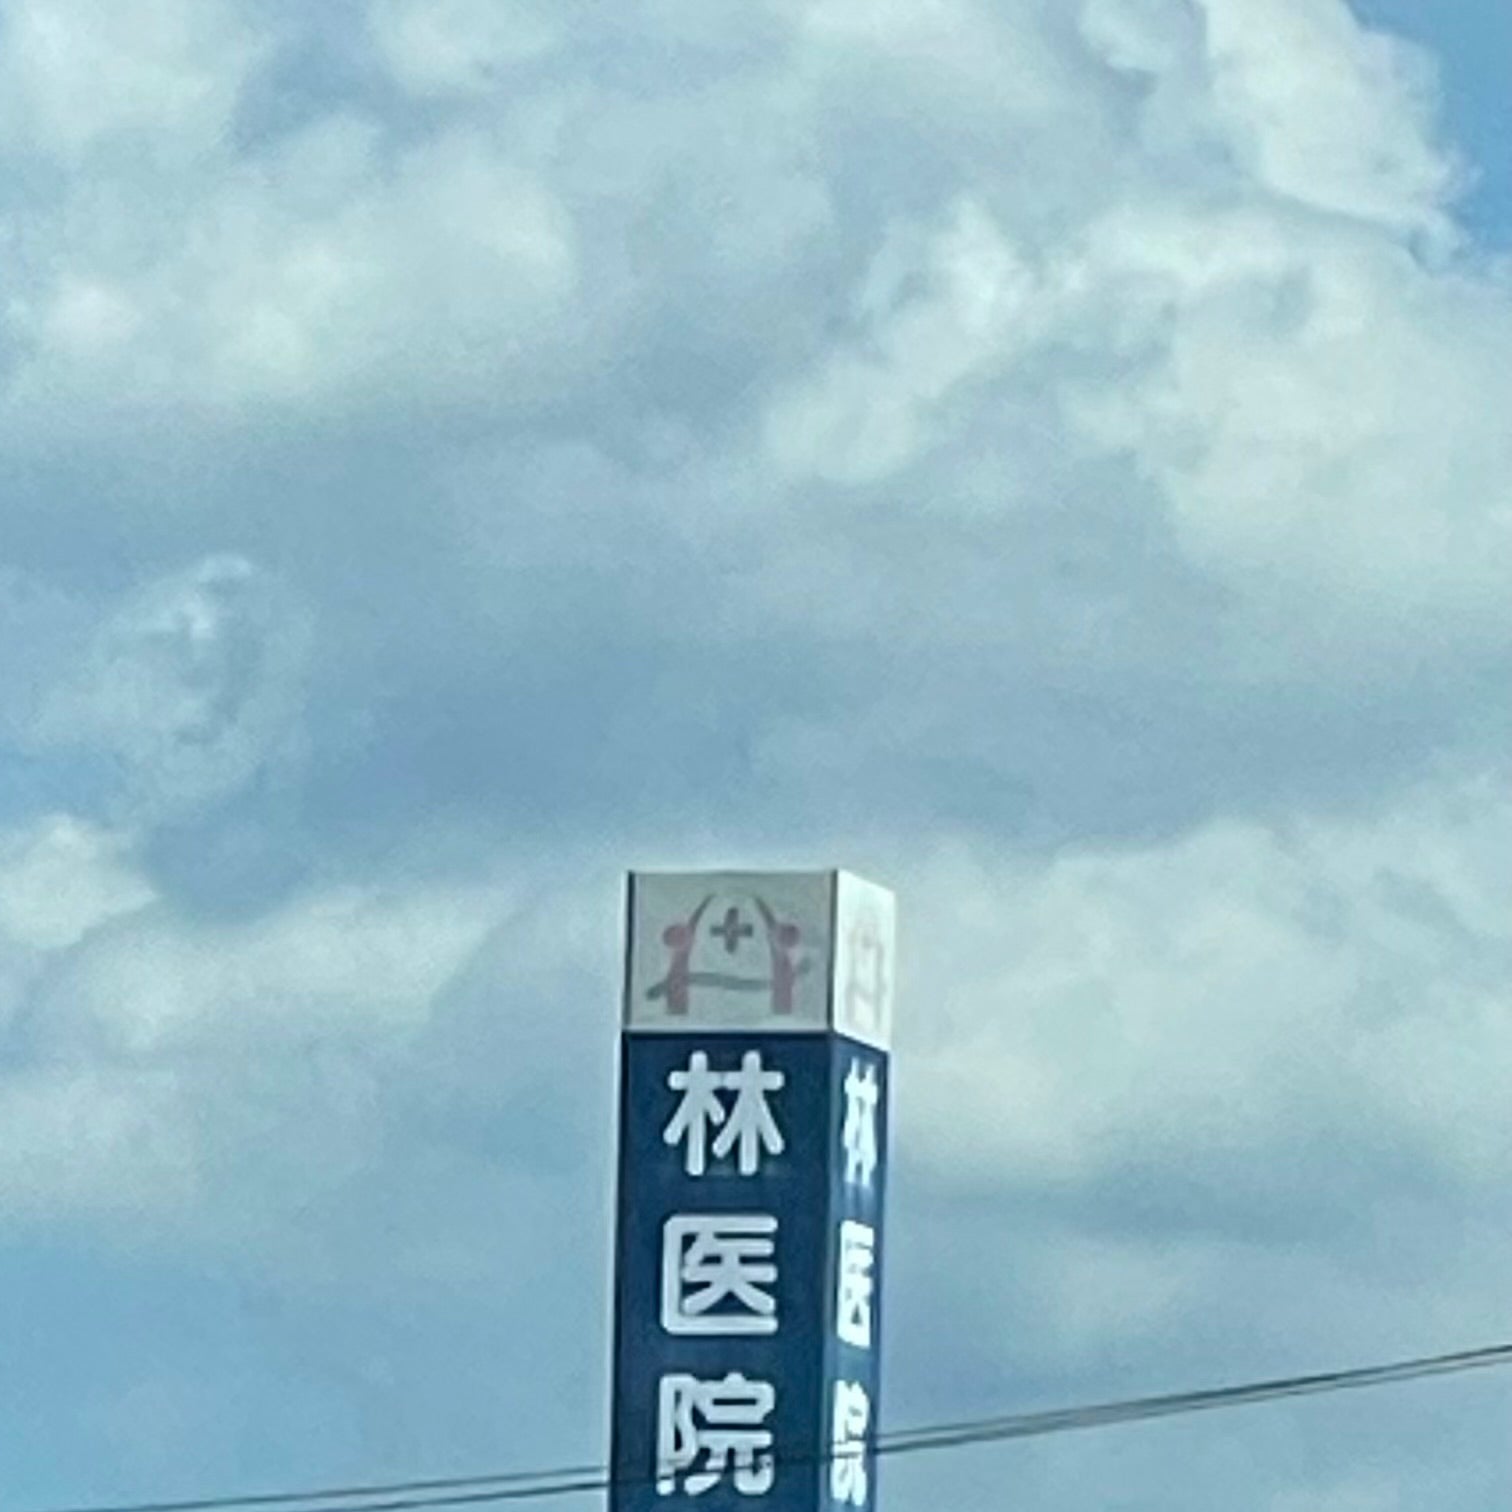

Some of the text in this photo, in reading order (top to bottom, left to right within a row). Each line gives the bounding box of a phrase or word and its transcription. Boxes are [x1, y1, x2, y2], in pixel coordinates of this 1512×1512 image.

[656, 1050, 785, 1496] 林医院
[830, 1060, 876, 1506] 林医院
